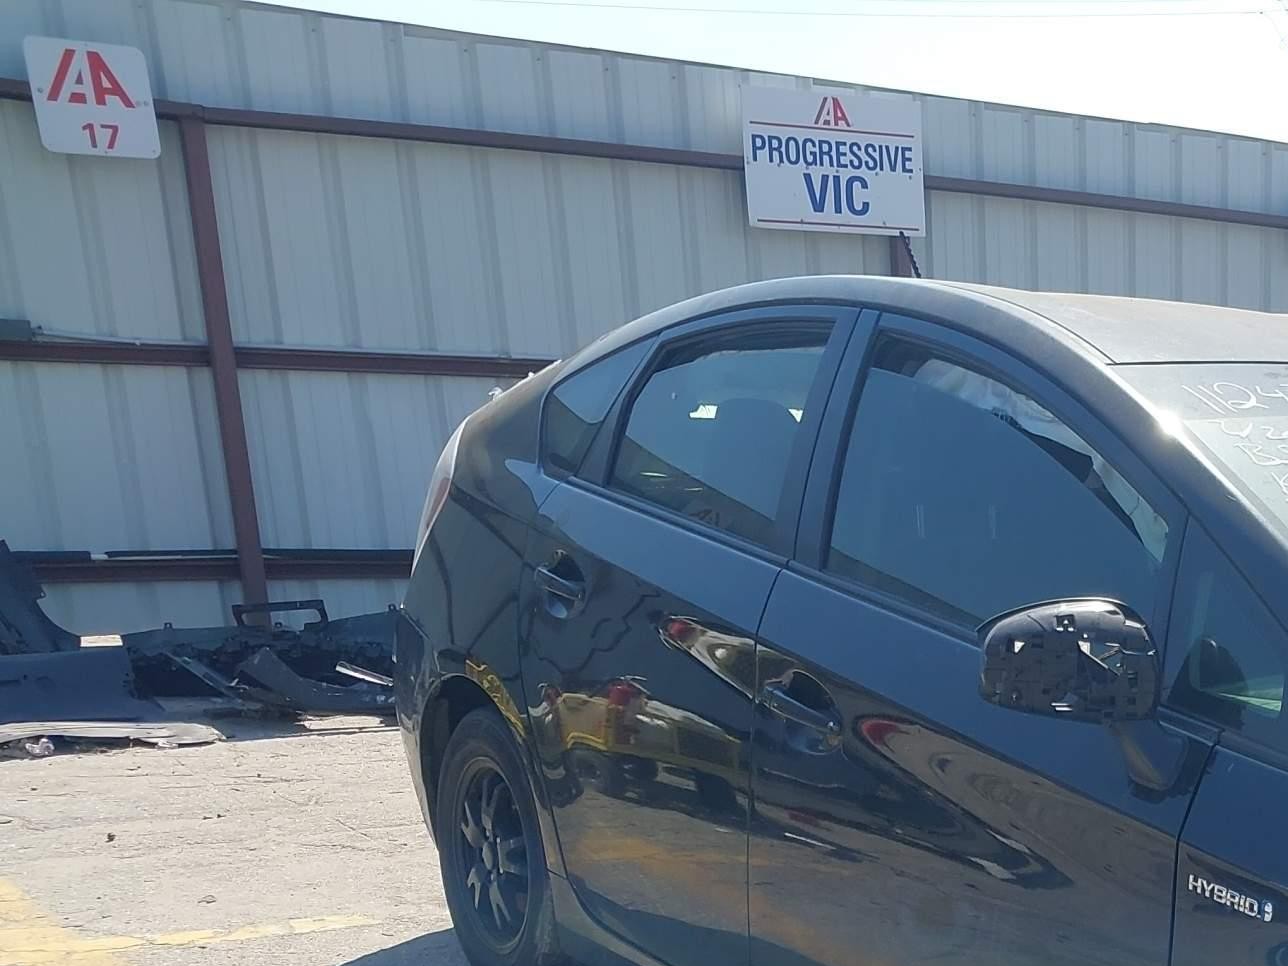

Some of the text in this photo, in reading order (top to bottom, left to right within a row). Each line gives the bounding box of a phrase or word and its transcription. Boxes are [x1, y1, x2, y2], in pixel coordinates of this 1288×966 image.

[81, 123, 119, 150] 17
[751, 134, 914, 174] PROGRESSIVE
[803, 172, 870, 216] VIC
[1187, 873, 1259, 918] HYBRID
